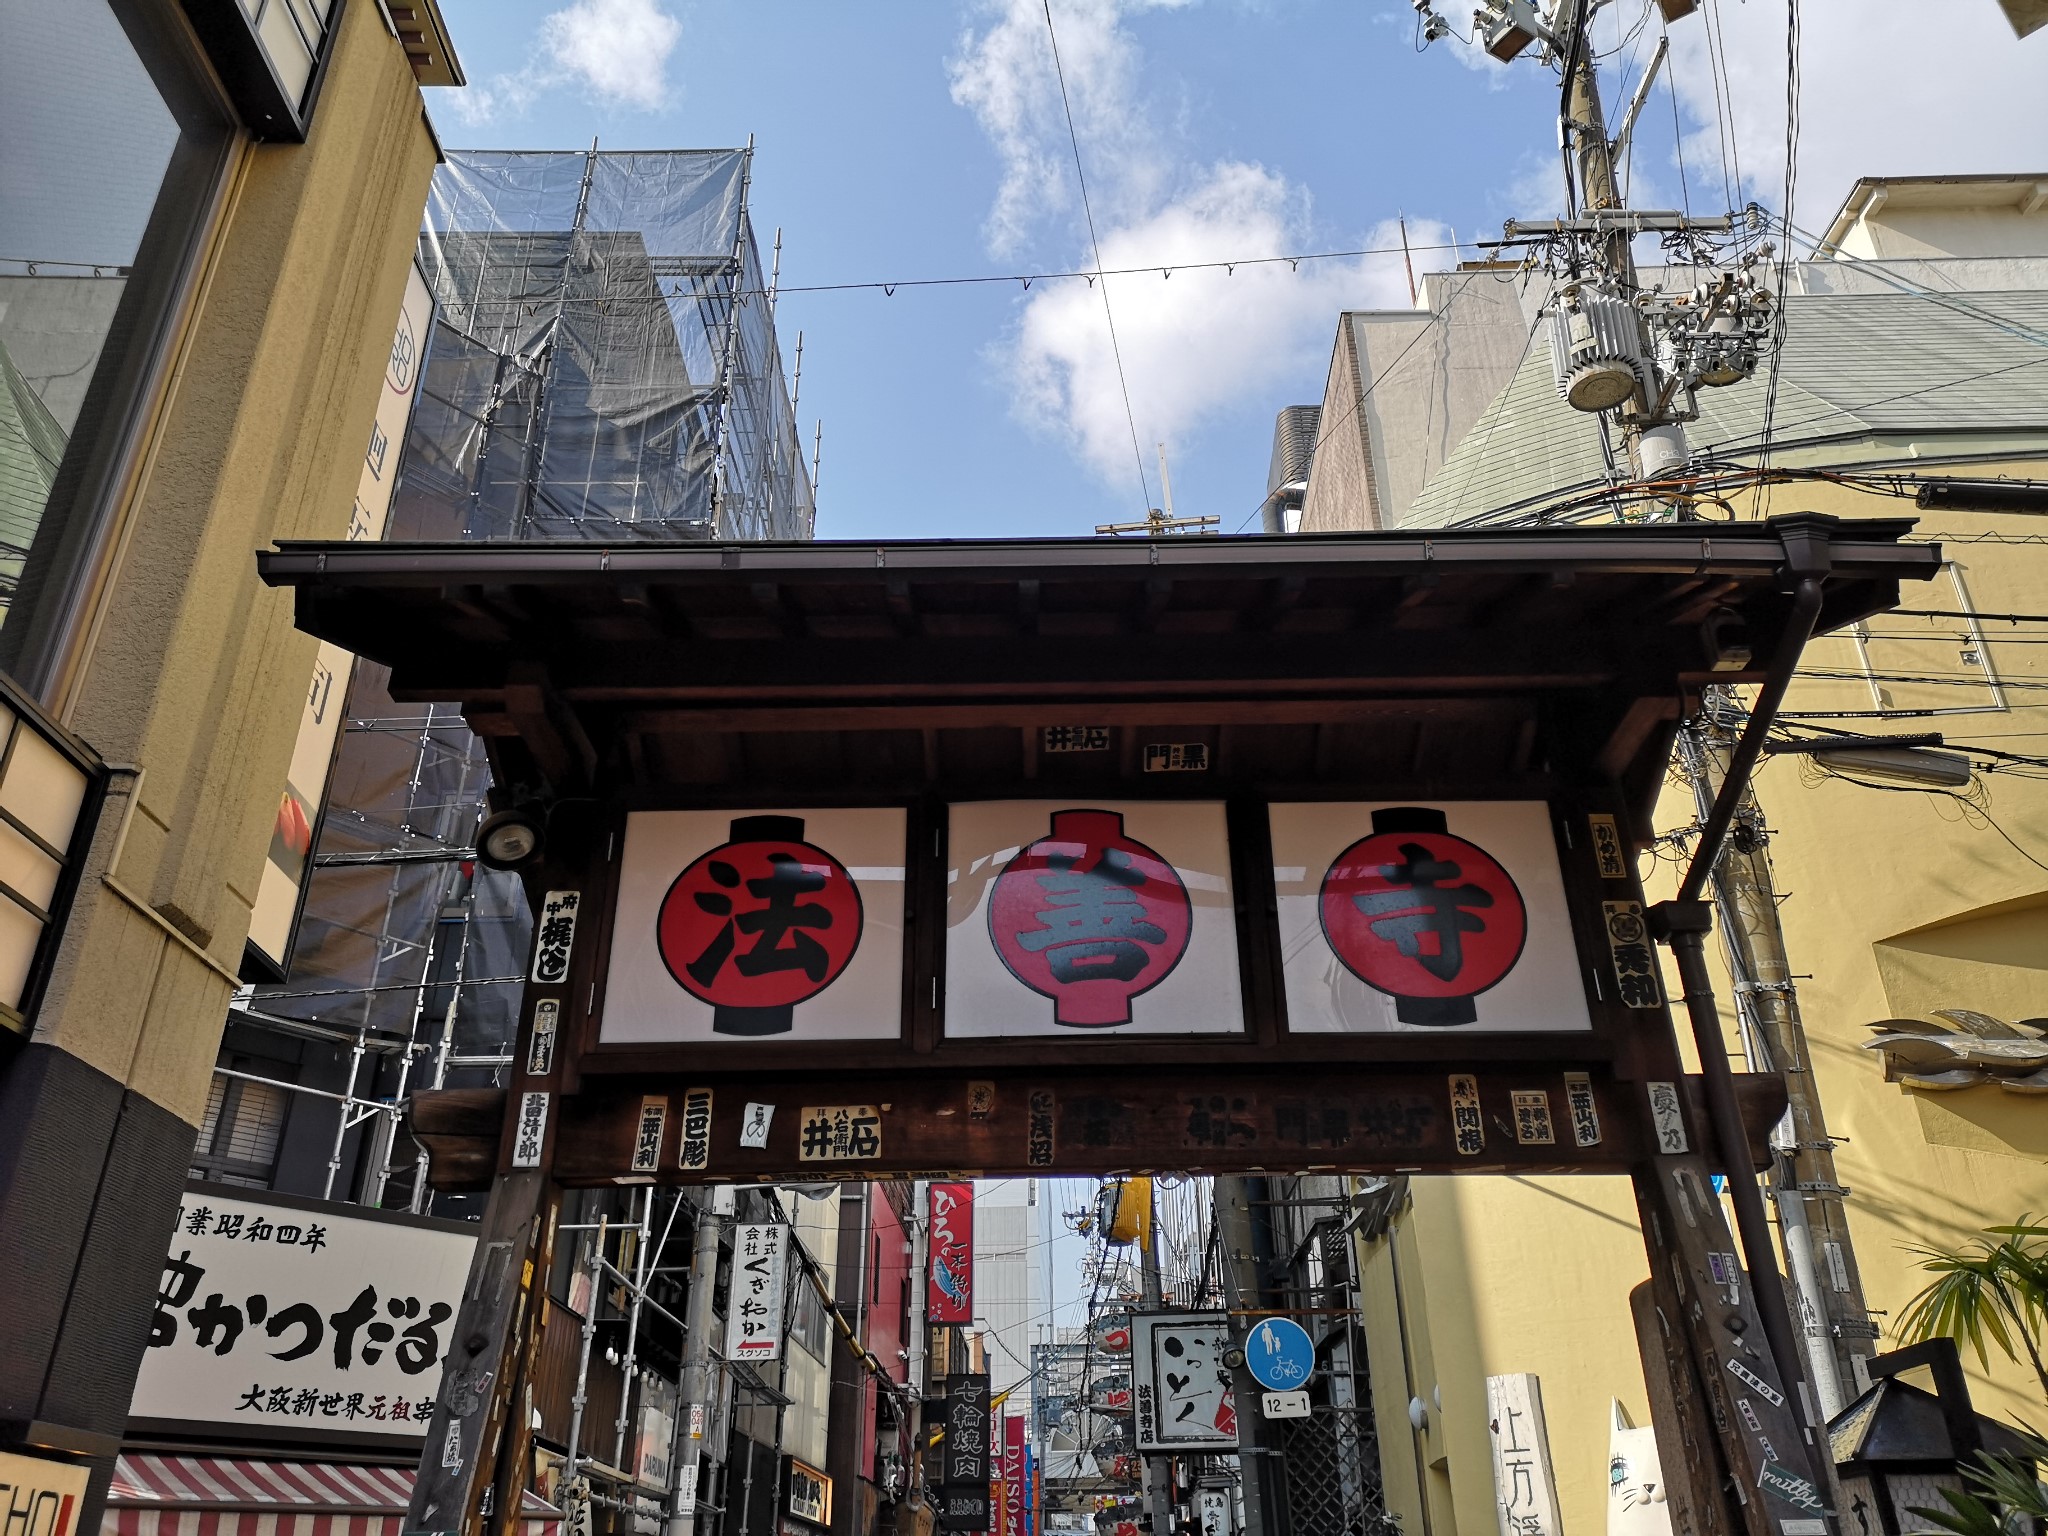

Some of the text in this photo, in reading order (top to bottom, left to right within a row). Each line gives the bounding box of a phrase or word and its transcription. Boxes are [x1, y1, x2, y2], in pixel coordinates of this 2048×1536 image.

[686, 843, 1495, 988] 法 善 寺
[737, 1349, 772, 1358] スグソコ
[953, 1380, 984, 1478] 七輪焼肉
[1006, 1444, 1020, 1514] DAISO
